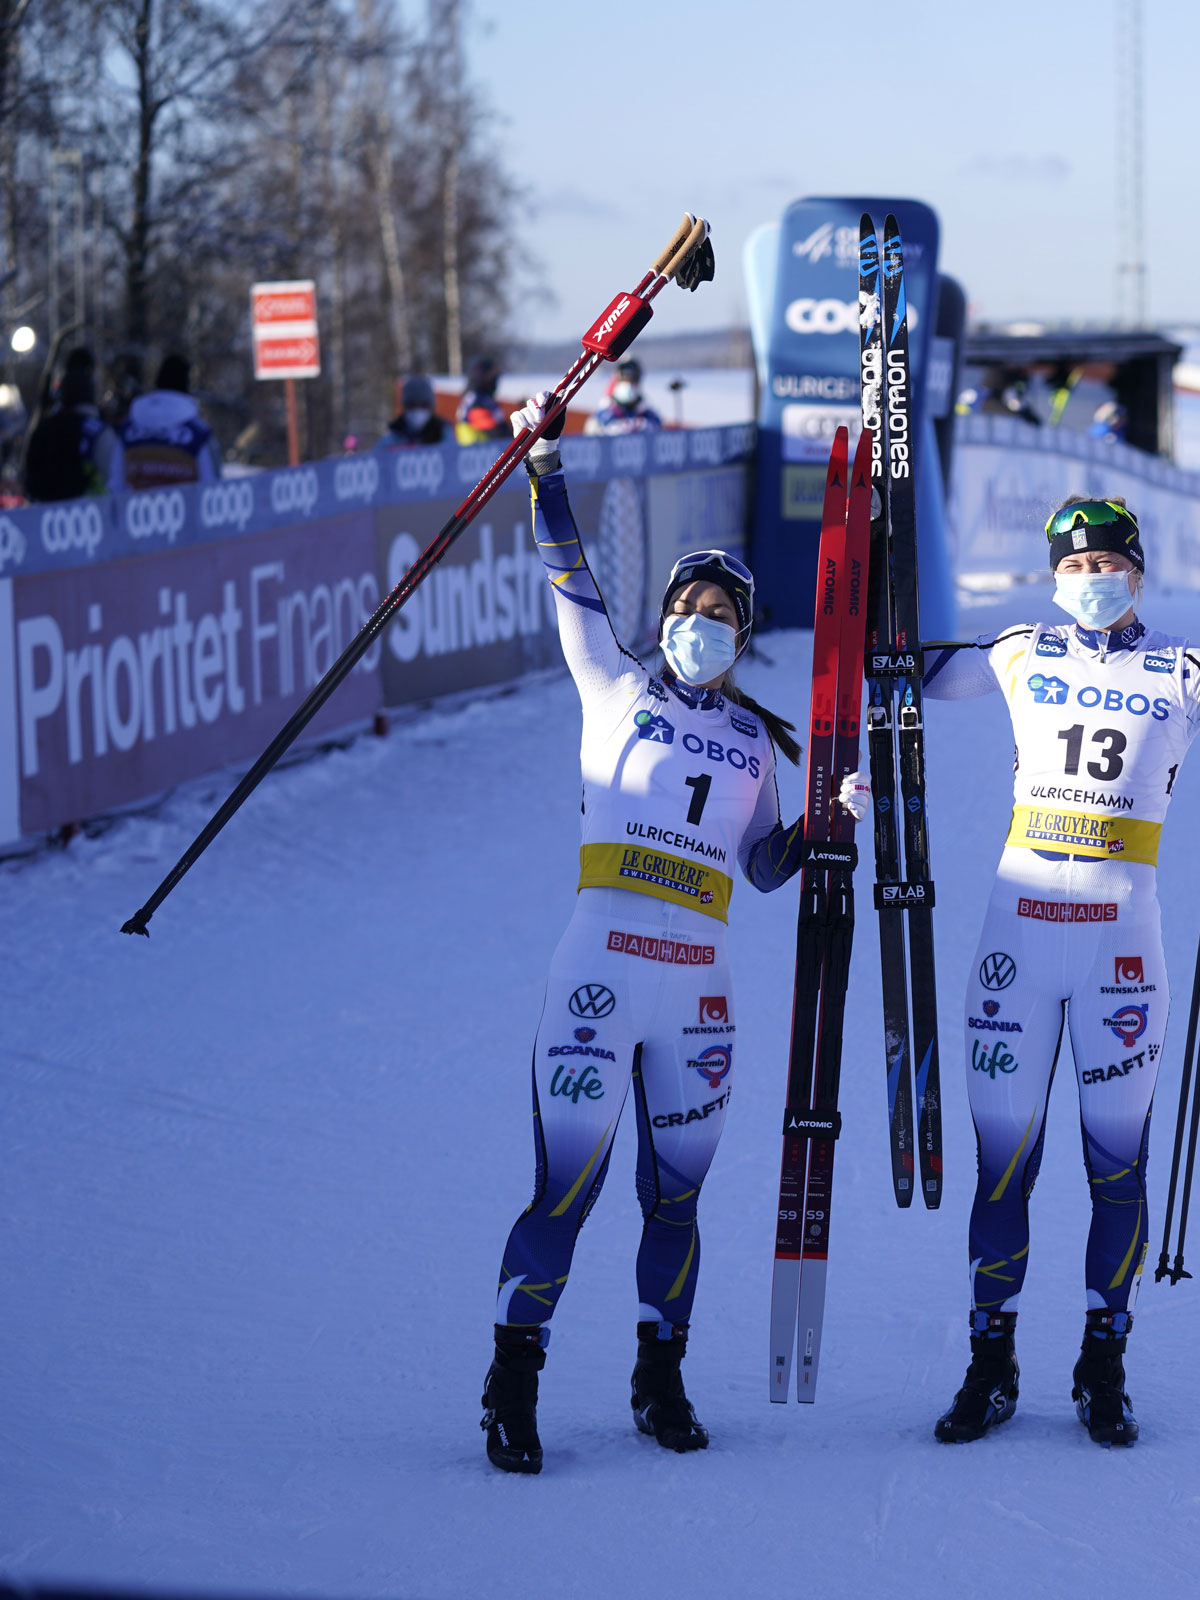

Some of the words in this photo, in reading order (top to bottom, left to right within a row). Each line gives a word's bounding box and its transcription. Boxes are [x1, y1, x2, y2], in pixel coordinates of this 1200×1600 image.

[887, 349, 909, 479] salomon
[334, 456, 379, 503] coop
[396, 450, 444, 496] coop
[202, 482, 252, 531] coop
[271, 468, 318, 516] coop
[41, 503, 103, 558] coop
[127, 491, 184, 543] coop
[823, 557, 836, 616] ATOMIC
[848, 558, 861, 617] ATOMIC
[1037, 643, 1066, 654] coop
[1145, 658, 1174, 670] coop
[18, 579, 245, 778] Prioritet
[251, 560, 382, 705] Finans
[1077, 686, 1170, 721] OBOS
[682, 733, 760, 779] OBOS
[1057, 723, 1127, 781] 13
[684, 773, 712, 826] 1
[815, 766, 824, 816] REDSTER
[1030, 785, 1134, 810] ULRICEHAMN
[1028, 811, 1043, 829] LE
[626, 821, 726, 863] ULRICEHAMN
[1028, 831, 1102, 847] SWITZERLAND
[621, 849, 640, 869] LE
[816, 852, 852, 862] ATOMIC
[623, 869, 696, 895] SWITZERLAND
[1019, 899, 1117, 921] BAUHAUS
[609, 933, 714, 963] BAUHAUS
[1100, 986, 1139, 994] SVENSKA
[1140, 985, 1157, 993] SPEL
[682, 1026, 724, 1035] SVENSKA
[968, 1017, 1023, 1032] SCANIA
[1102, 1018, 1138, 1028] Thermia
[548, 1045, 616, 1062] SCANIA
[686, 1058, 725, 1069] Thermia
[971, 1039, 1018, 1080] life
[1082, 1052, 1146, 1085] CRAFT
[550, 1064, 604, 1104] life
[652, 1093, 727, 1128] CRAFT
[798, 1119, 833, 1129] ATOMIC
[779, 1210, 797, 1220] S9
[806, 1210, 825, 1220] S9
